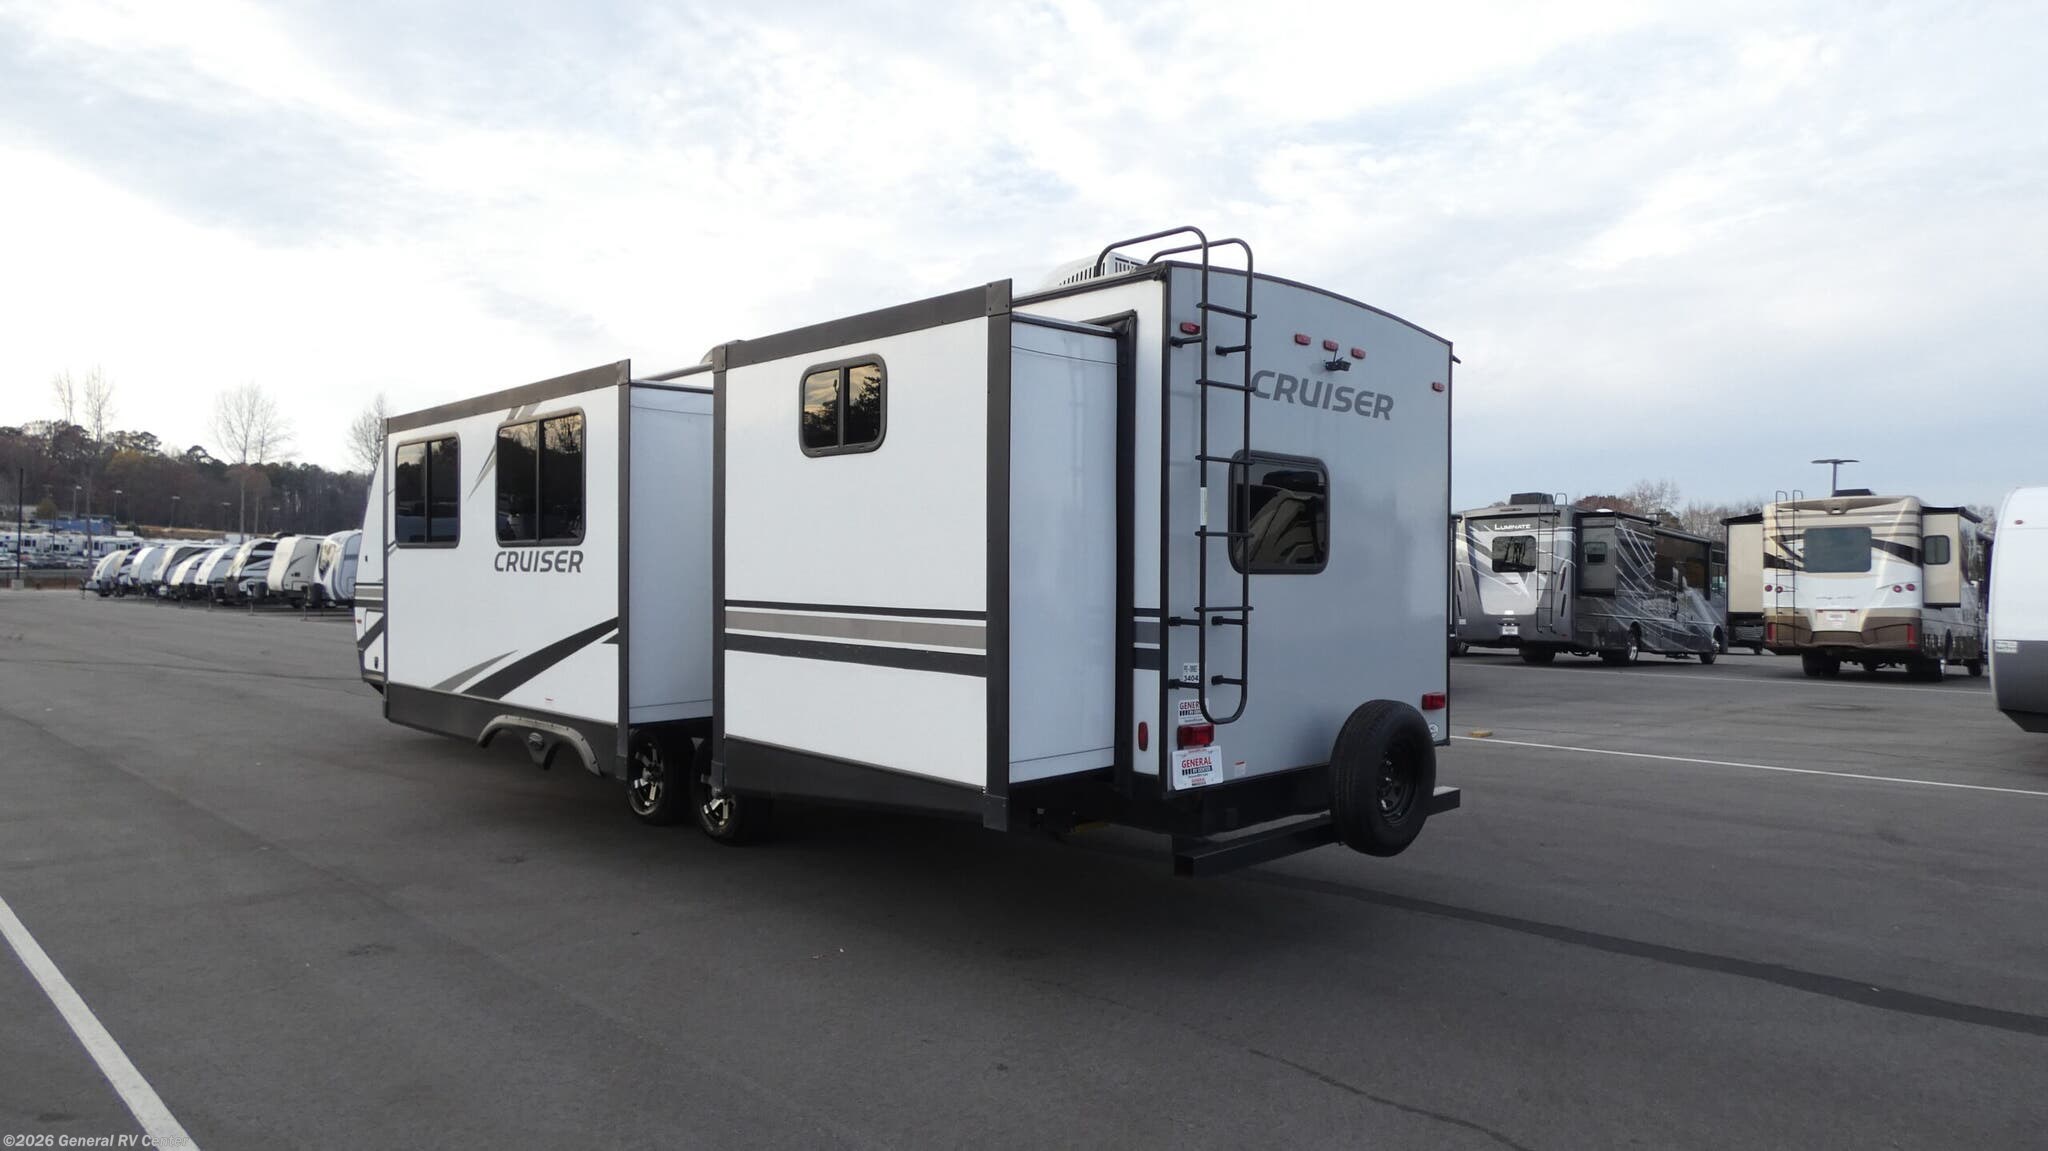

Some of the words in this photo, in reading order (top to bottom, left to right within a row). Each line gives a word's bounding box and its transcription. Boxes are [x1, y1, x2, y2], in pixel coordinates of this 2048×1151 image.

[1251, 369, 1395, 421] CRUISER
[494, 550, 584, 573] CRUISER
[1180, 701, 1200, 709] GENER
[1182, 757, 1212, 768] GENERAL
